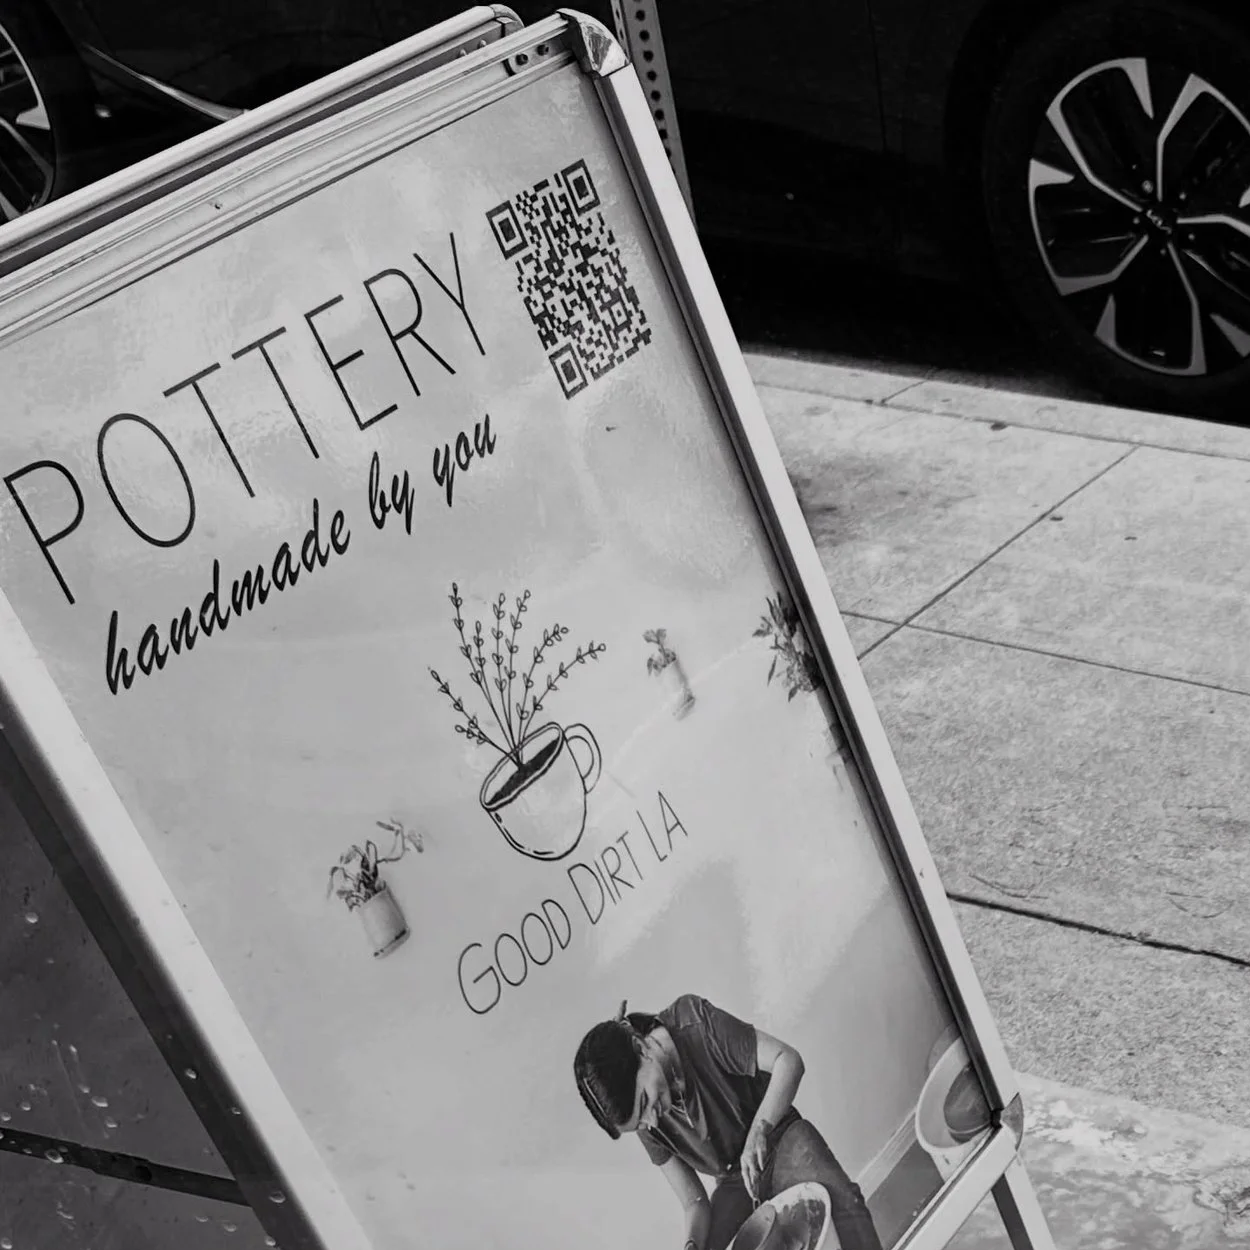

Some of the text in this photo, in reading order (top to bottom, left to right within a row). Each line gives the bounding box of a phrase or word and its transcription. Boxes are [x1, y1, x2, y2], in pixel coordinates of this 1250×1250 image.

[3, 232, 486, 605] POTTERY
[105, 414, 497, 695] handmade by you
[458, 790, 688, 1015] GOOD DIRT LA
